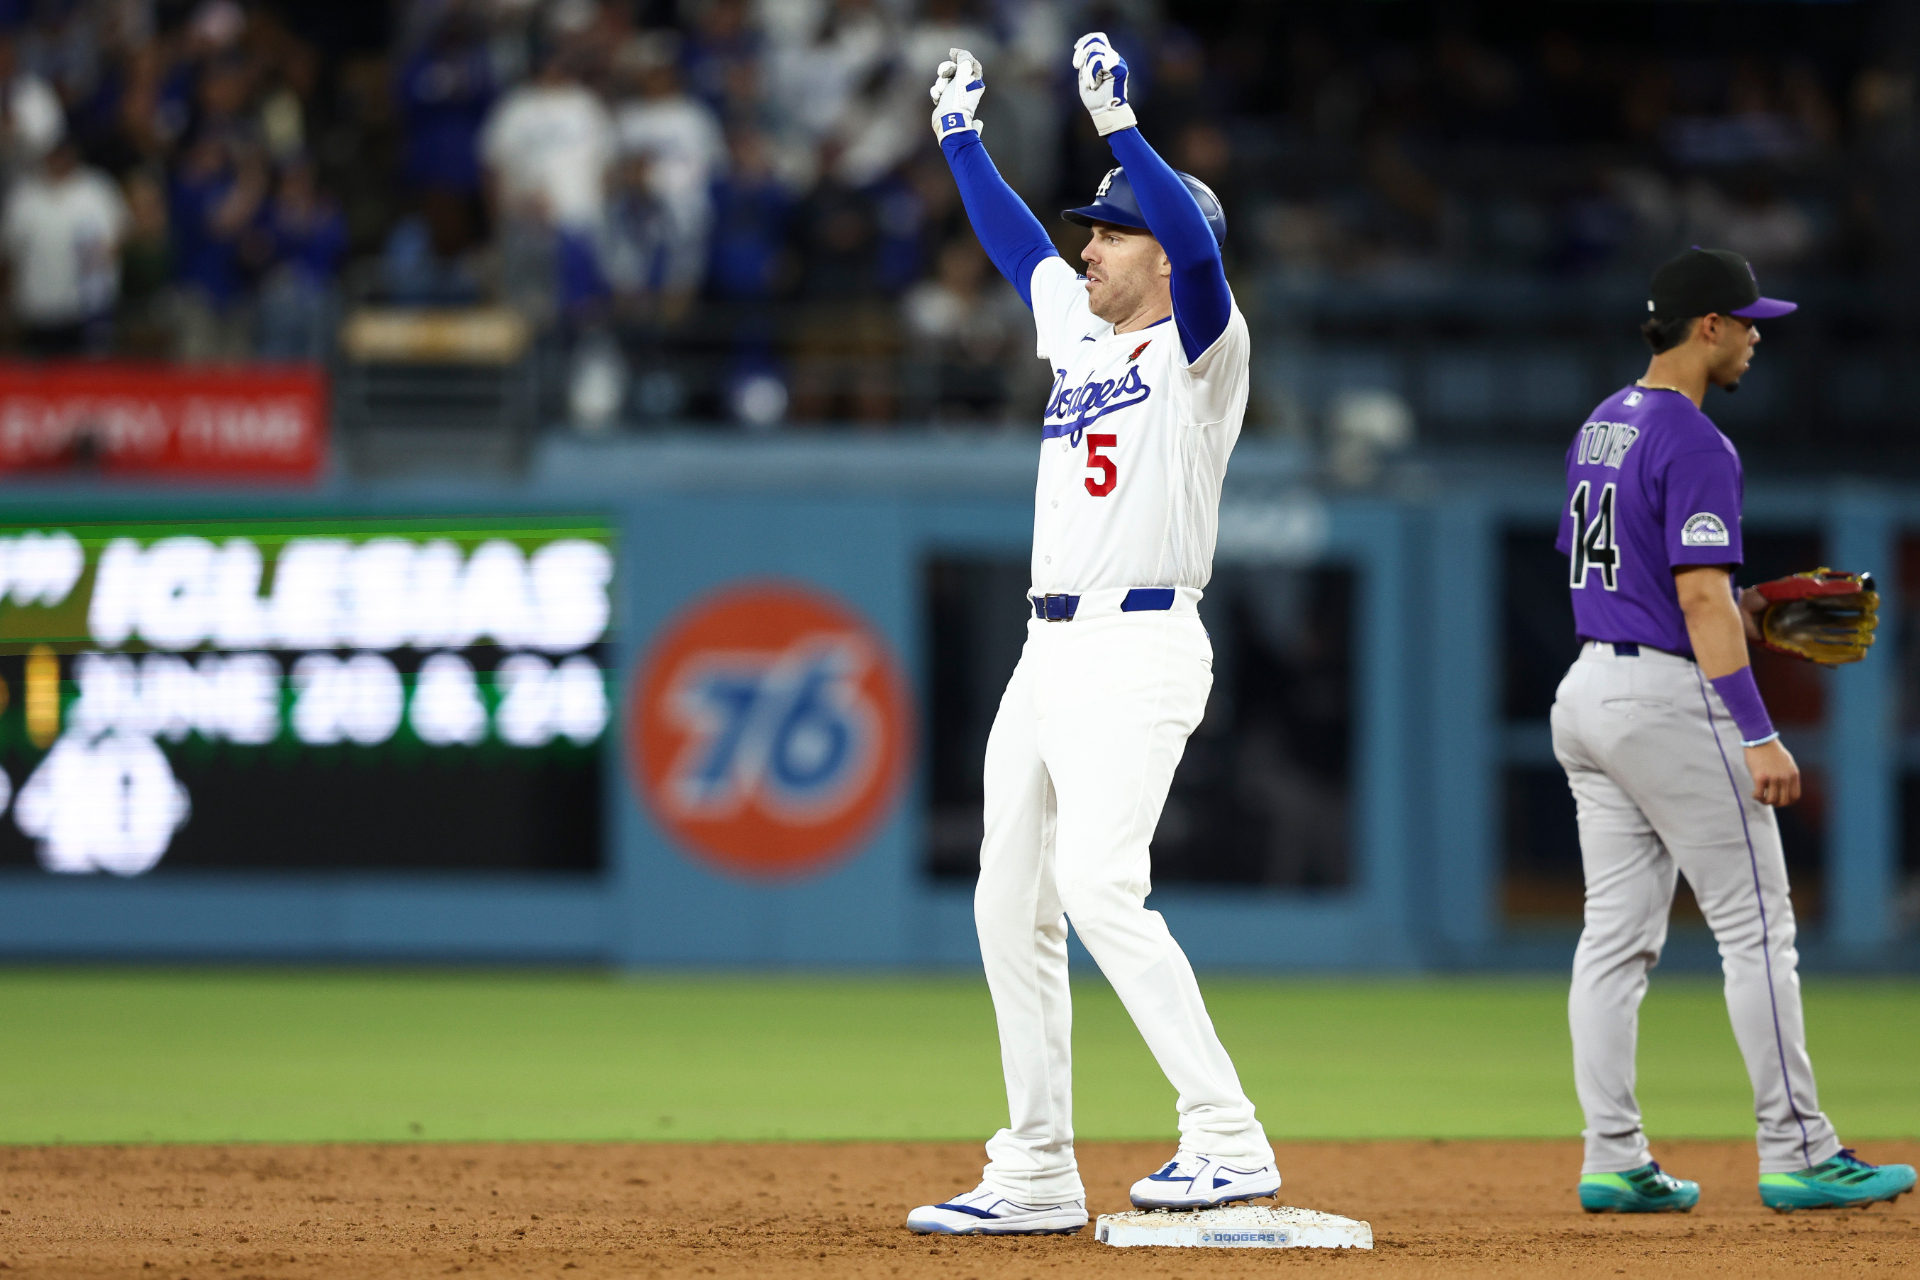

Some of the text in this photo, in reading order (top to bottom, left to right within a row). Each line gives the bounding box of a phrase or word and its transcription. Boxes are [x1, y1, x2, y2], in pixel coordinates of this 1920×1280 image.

[948, 114, 957, 127] 5
[1042, 365, 1151, 448] Dodgers
[1084, 434, 1117, 497] 5
[1570, 480, 1620, 591] 14
[88, 536, 614, 652] IGLESIAS
[666, 636, 882, 824] 76
[1214, 1233, 1275, 1242] DODGERS
